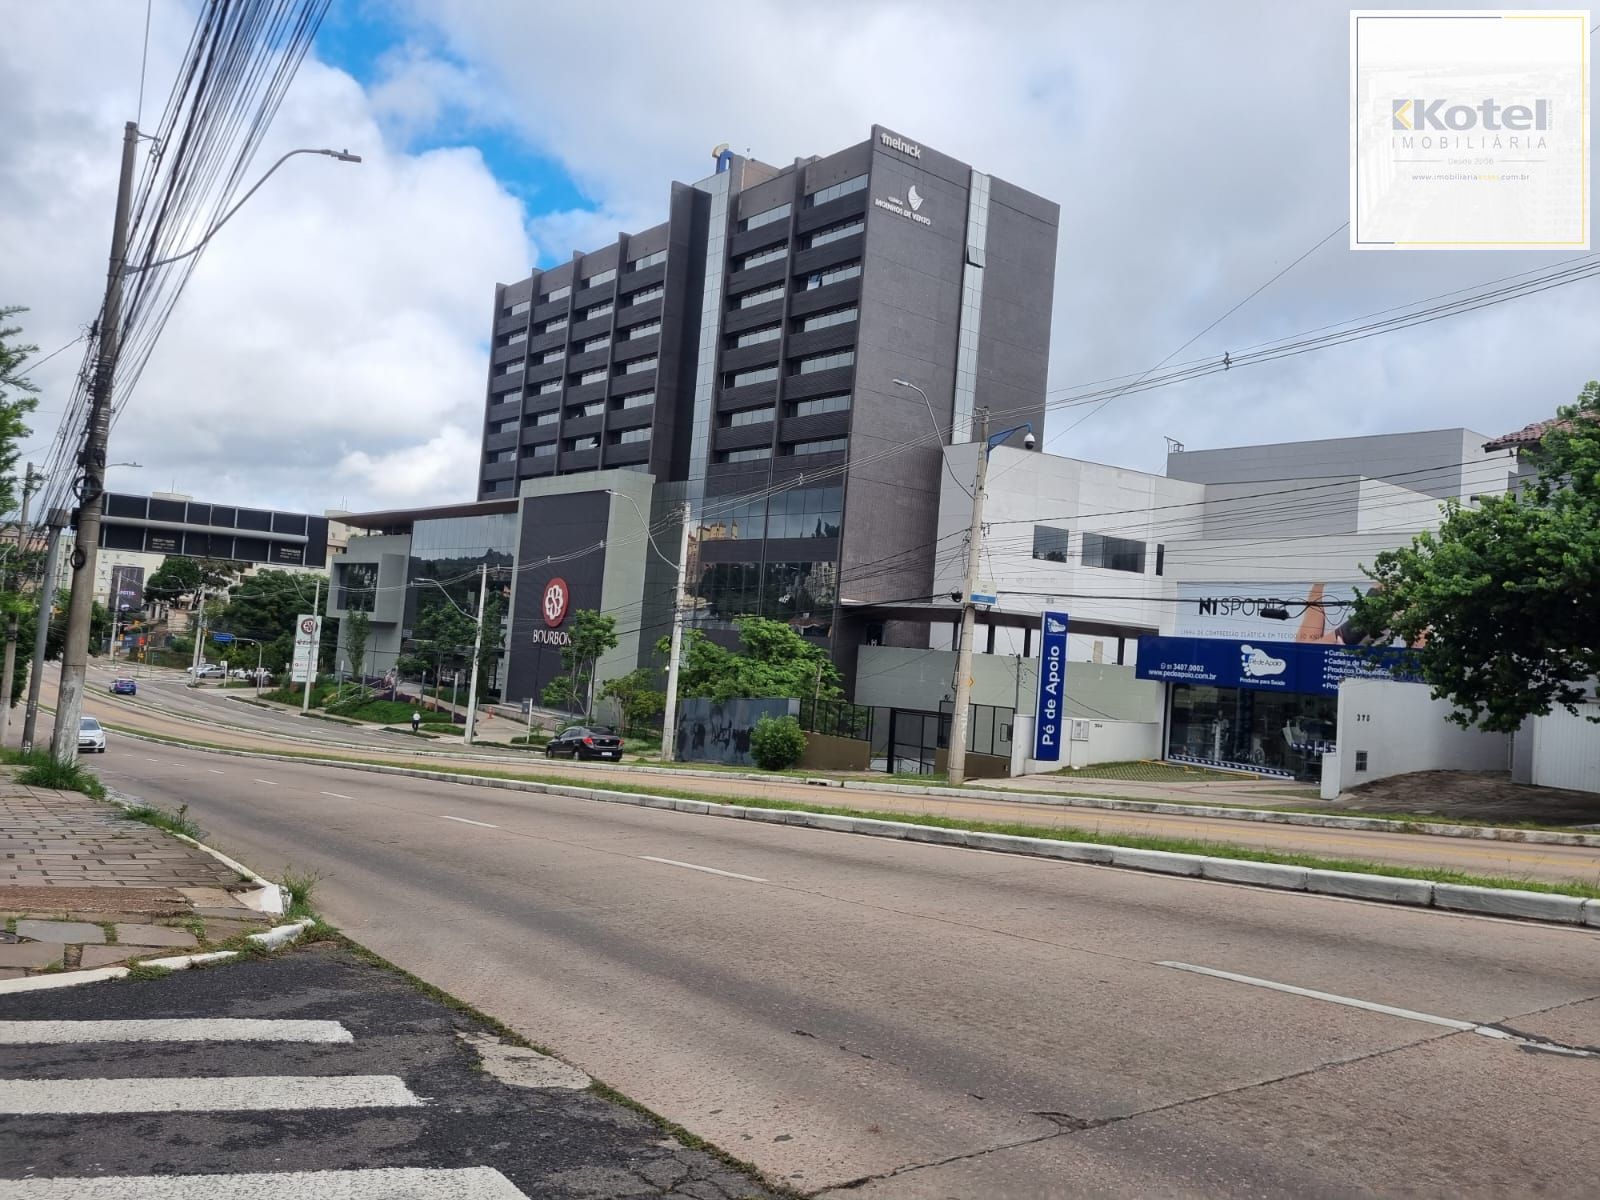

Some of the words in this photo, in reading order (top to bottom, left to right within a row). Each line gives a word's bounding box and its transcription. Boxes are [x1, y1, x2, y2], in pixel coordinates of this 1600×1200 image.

[881, 132, 921, 159] melnick
[875, 198, 903, 215] MOINHOS
[903, 209, 912, 218] DE
[912, 211, 931, 226] VENTO
[1046, 645, 1060, 695] Apoio
[1148, 669, 1217, 680] www.pedeapoio.com.br
[1044, 698, 1056, 719] de
[1042, 725, 1055, 745] Pé
